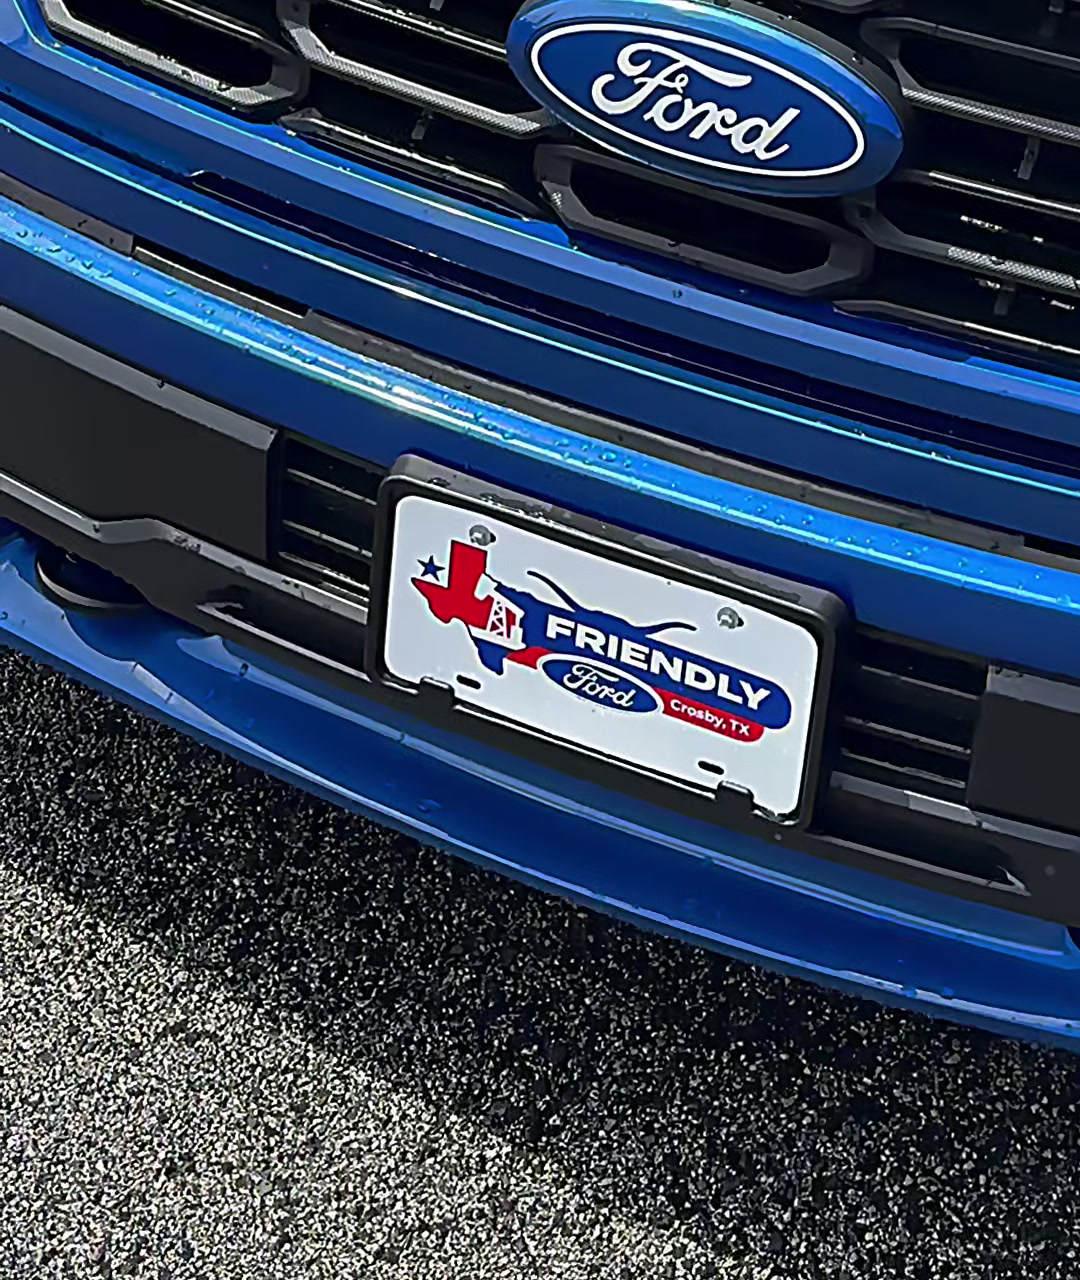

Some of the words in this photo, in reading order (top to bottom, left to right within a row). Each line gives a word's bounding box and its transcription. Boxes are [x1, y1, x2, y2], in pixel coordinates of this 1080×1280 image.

[591, 42, 801, 160] Ford
[546, 614, 771, 710] FRIENDLY
[563, 663, 636, 708] Ford
[670, 699, 727, 729] Crosby,
[729, 719, 751, 736] TX
